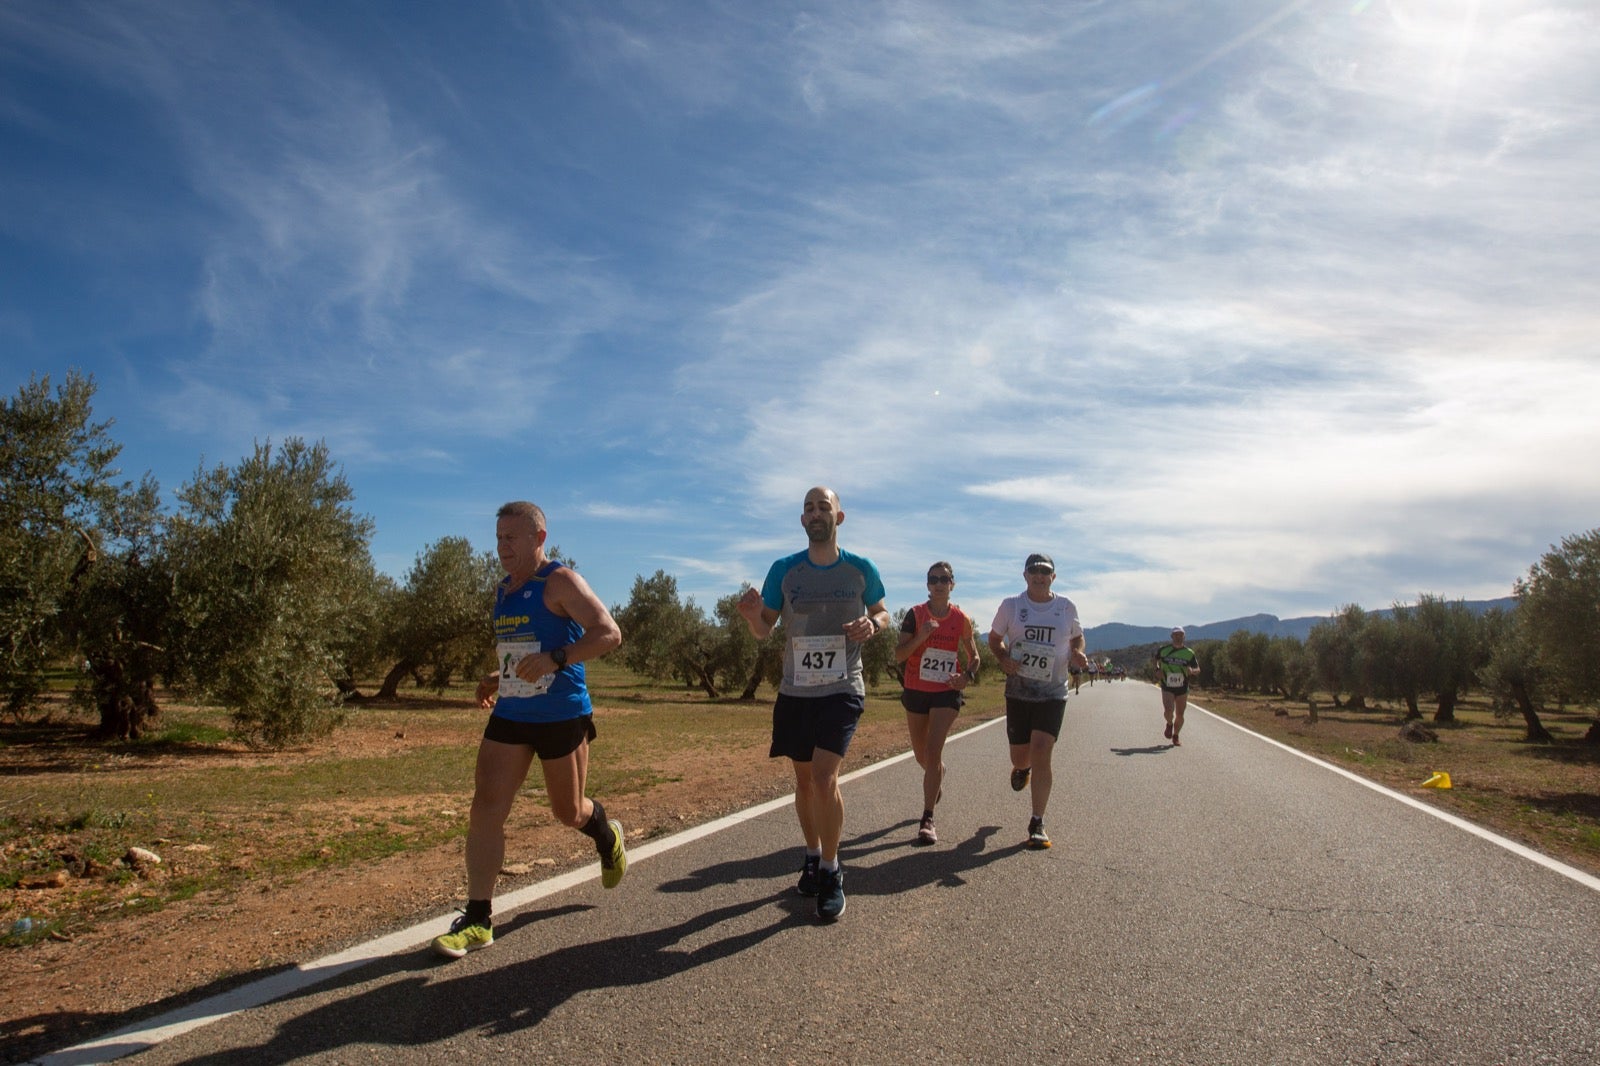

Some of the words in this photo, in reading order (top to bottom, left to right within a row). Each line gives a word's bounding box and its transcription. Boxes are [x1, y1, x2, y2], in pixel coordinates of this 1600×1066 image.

[495, 615, 530, 627] olimpo
[802, 651, 836, 669] 437
[922, 657, 955, 673] 2217
[1022, 652, 1048, 669] 276
